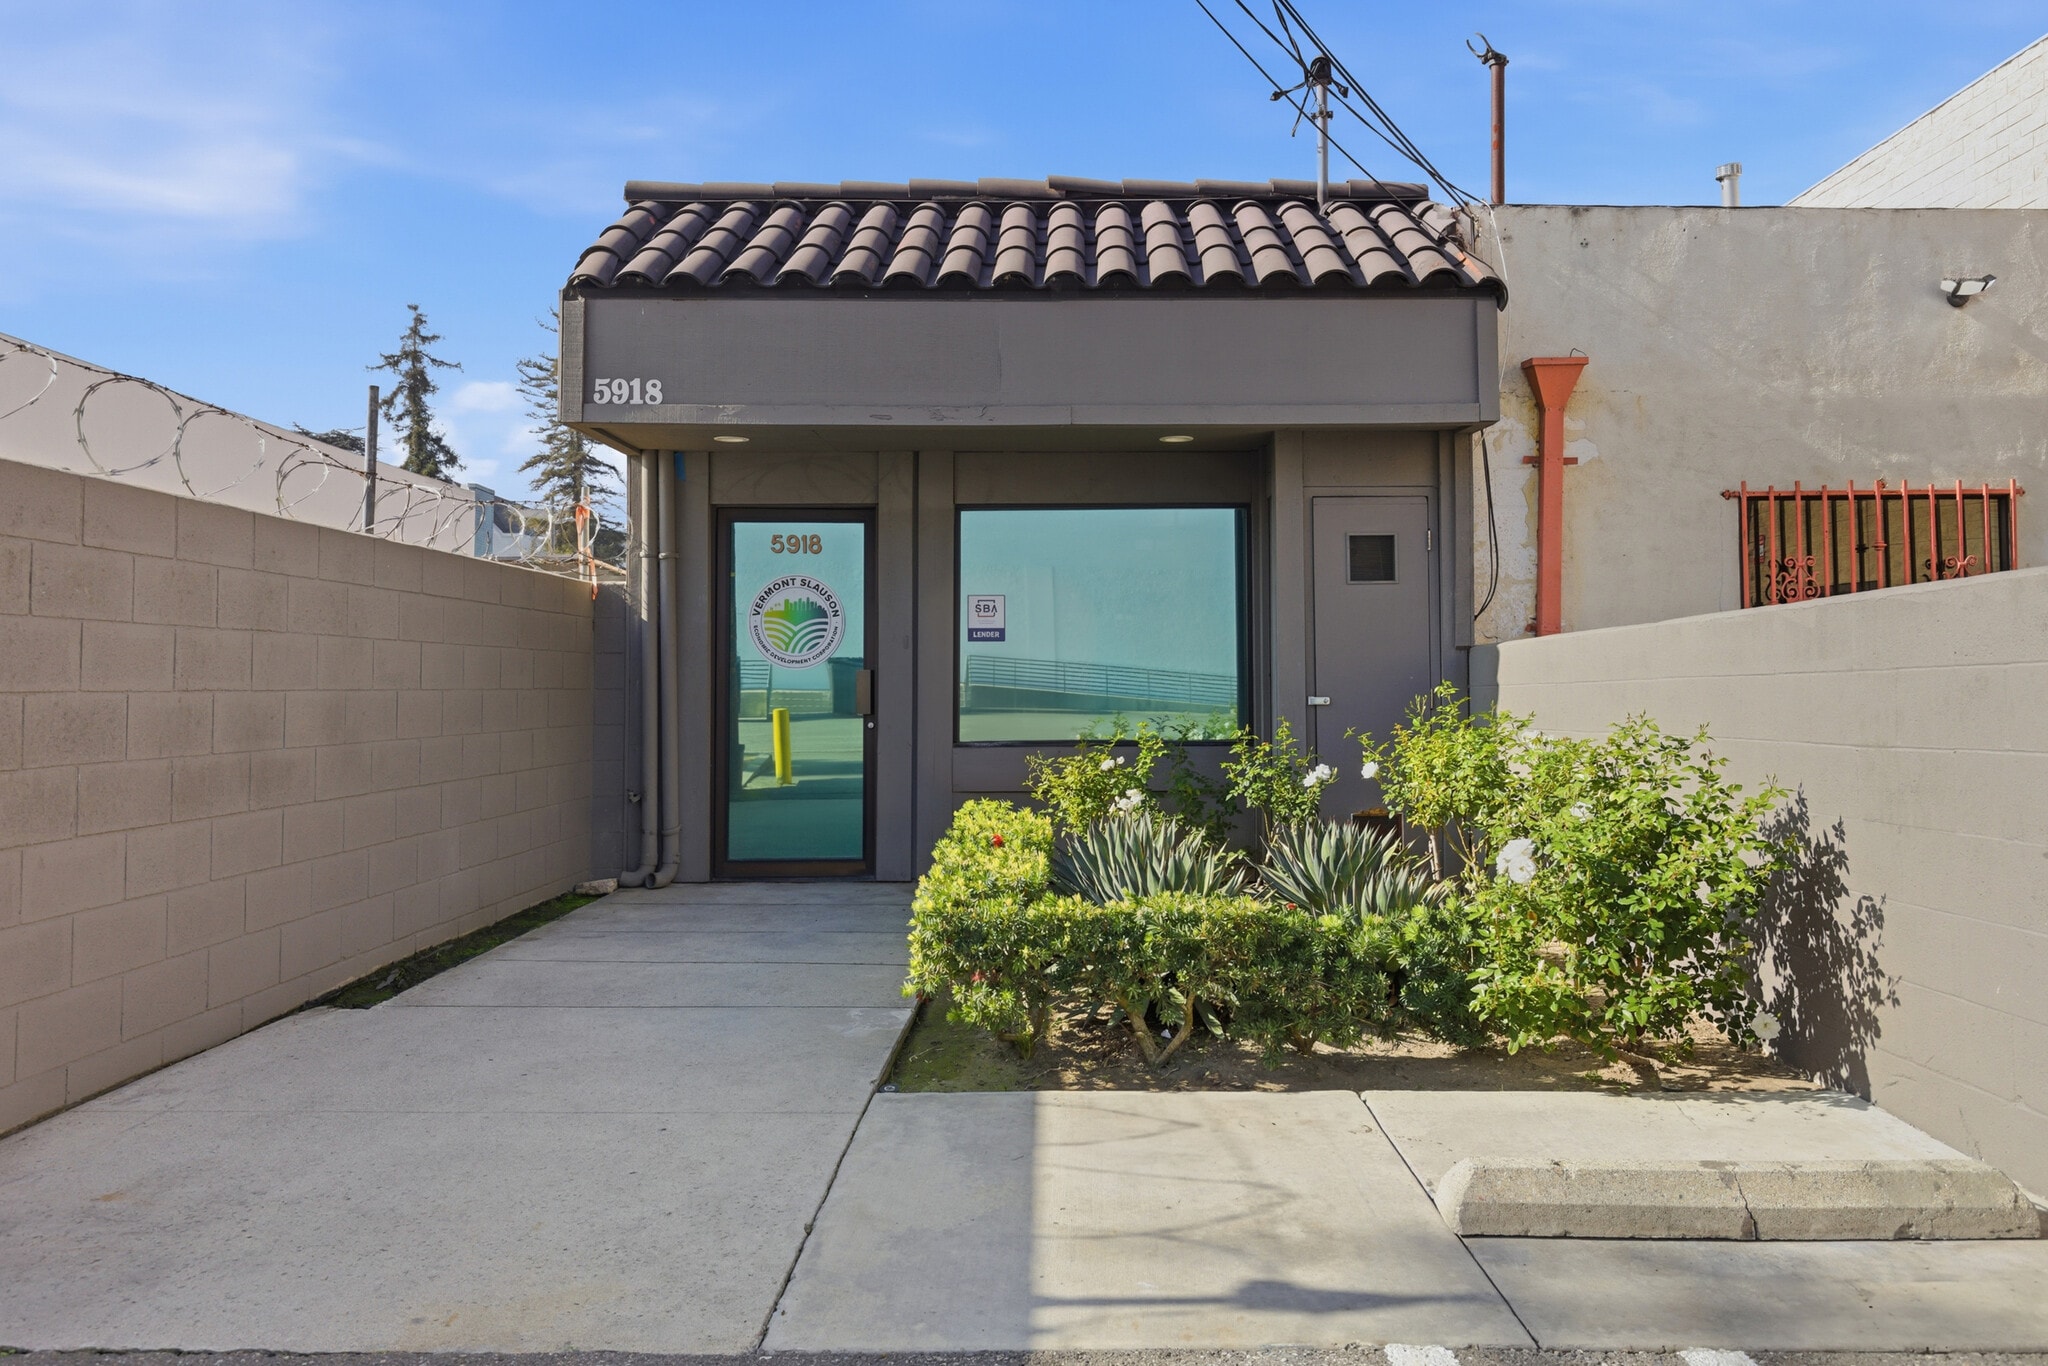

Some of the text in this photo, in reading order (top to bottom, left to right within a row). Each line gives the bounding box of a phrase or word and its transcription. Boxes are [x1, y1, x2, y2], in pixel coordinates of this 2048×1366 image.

[593, 378, 663, 405] 5918
[771, 534, 823, 554] 5918
[752, 578, 840, 618] VERMONT SLAUSON
[975, 604, 998, 613] SBA
[770, 651, 812, 664] DEVELOPMENT
[812, 626, 839, 660] CORPORATION
